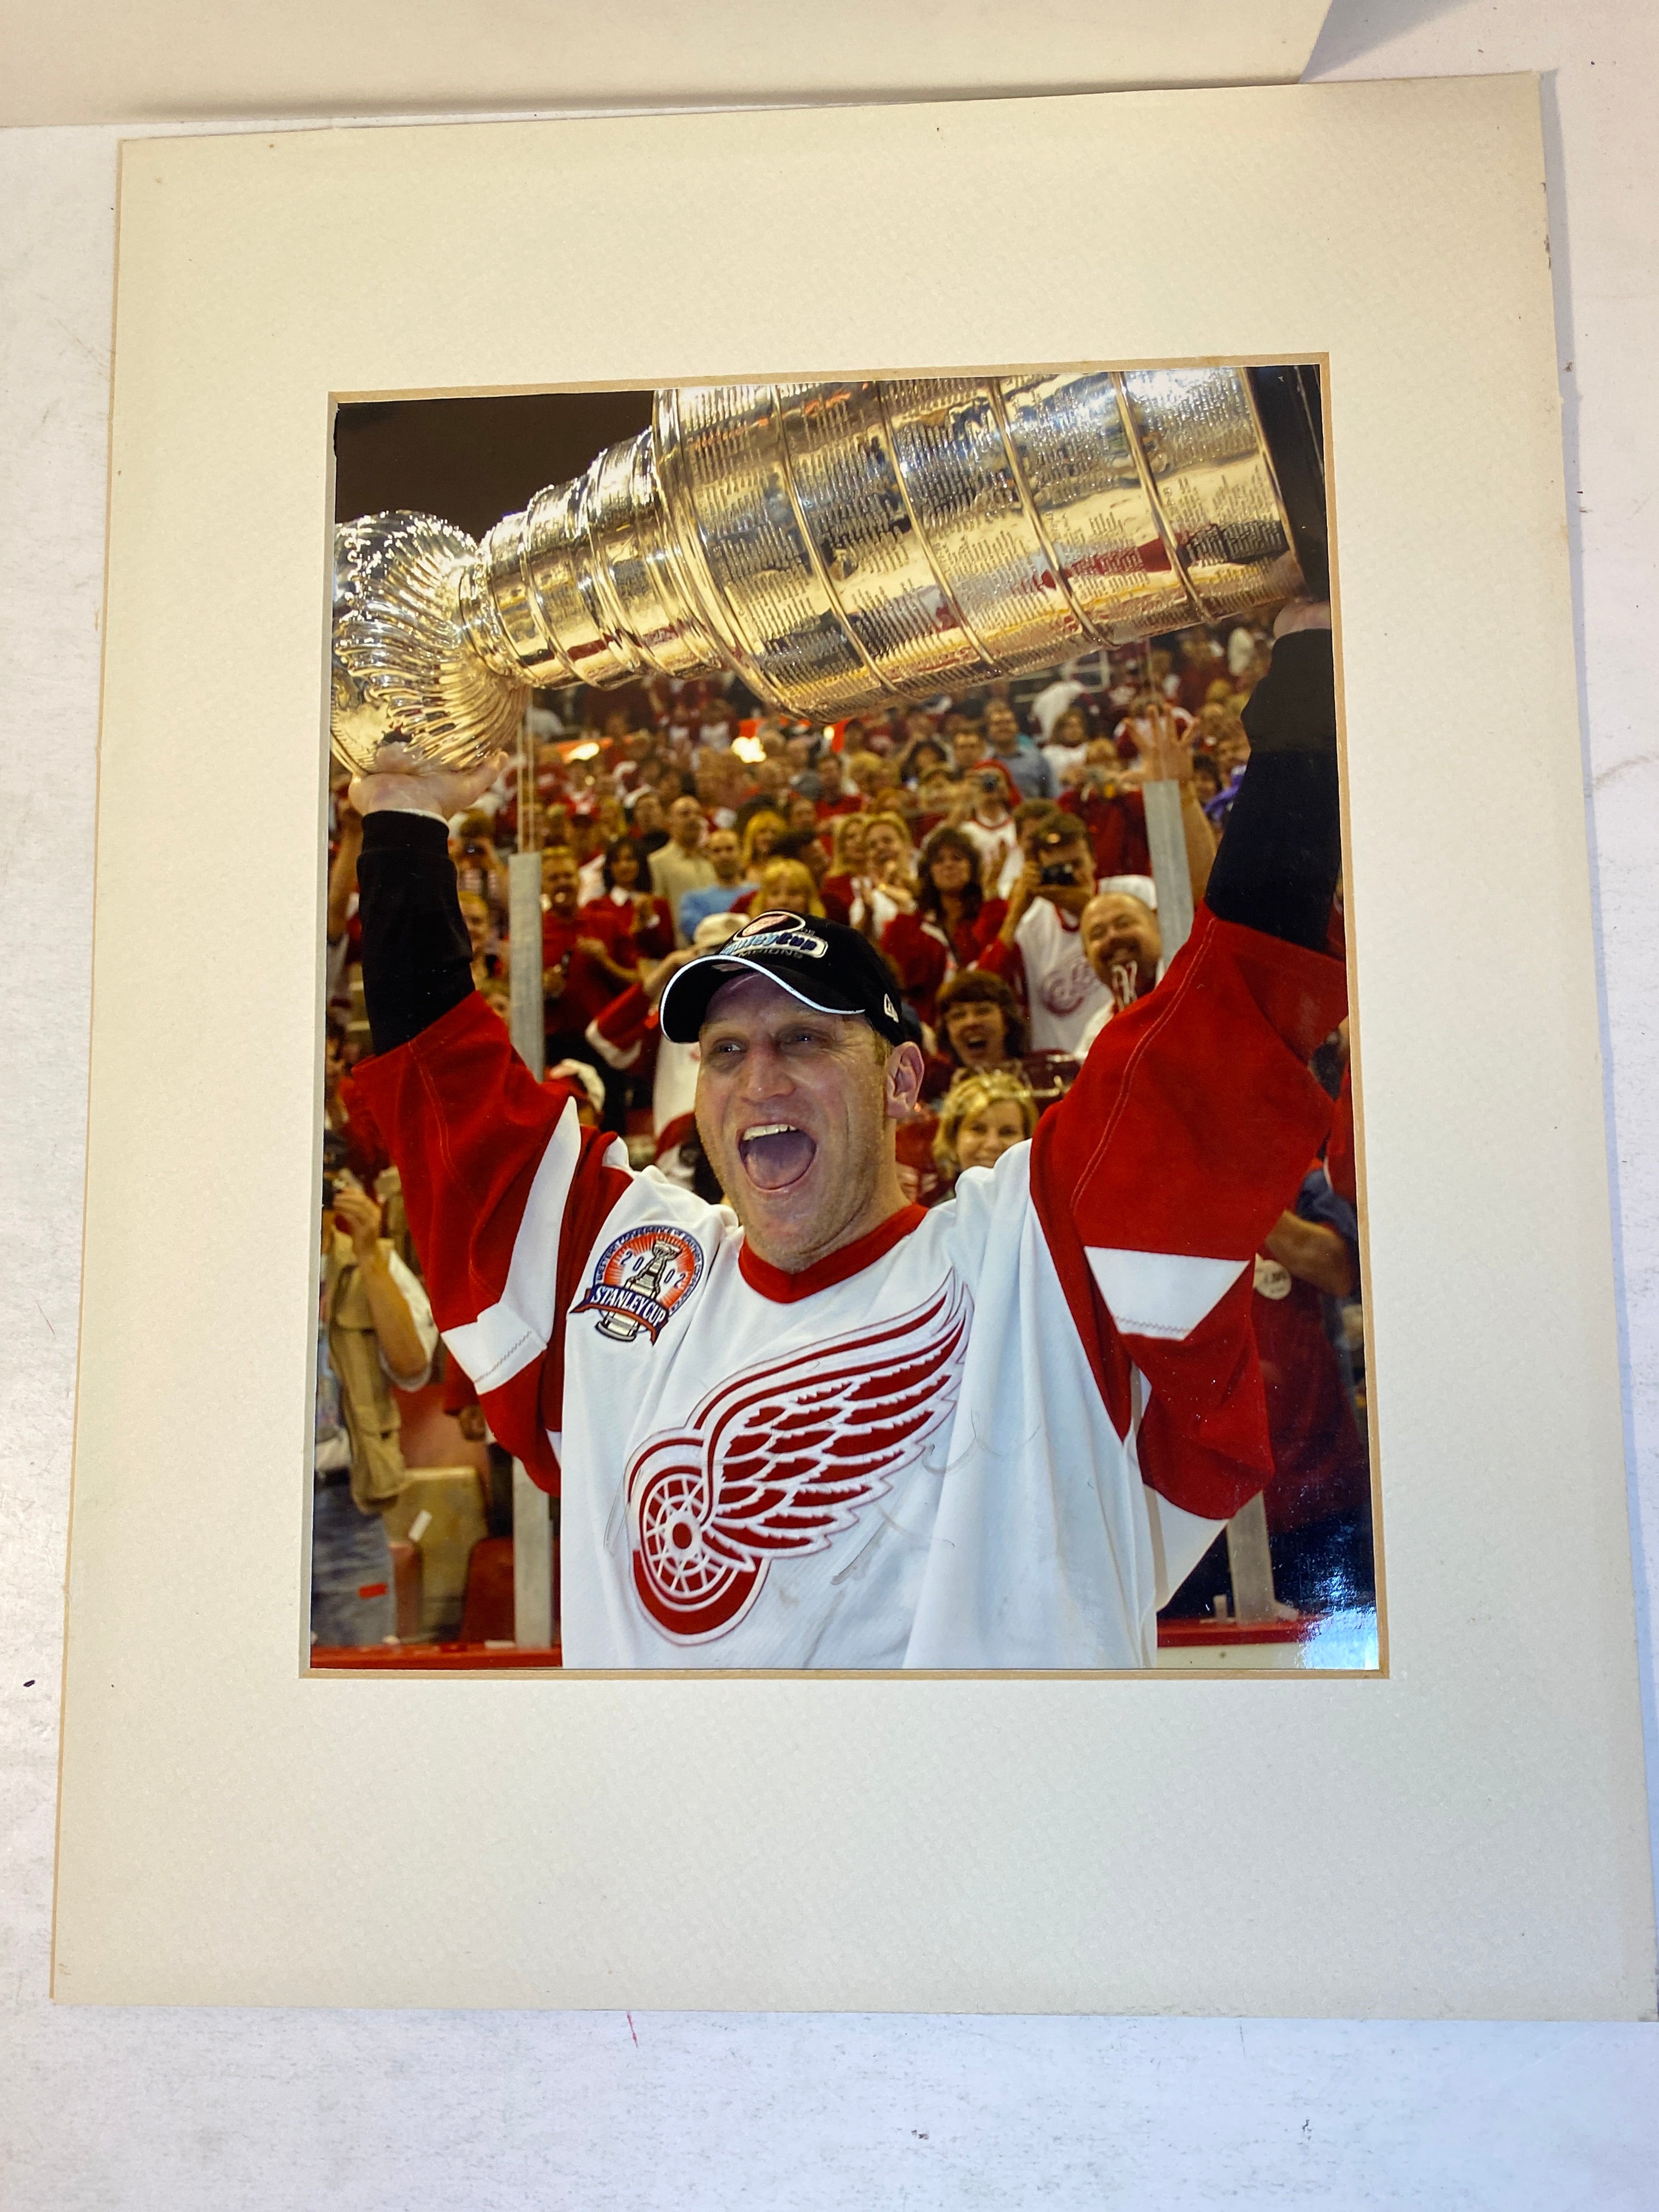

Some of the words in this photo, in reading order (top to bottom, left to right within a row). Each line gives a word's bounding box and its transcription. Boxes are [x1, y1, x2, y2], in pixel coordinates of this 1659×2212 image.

[776, 932, 817, 951] Cup
[590, 1285, 650, 1313] STANLEY
[644, 1301, 667, 1325] CUP
